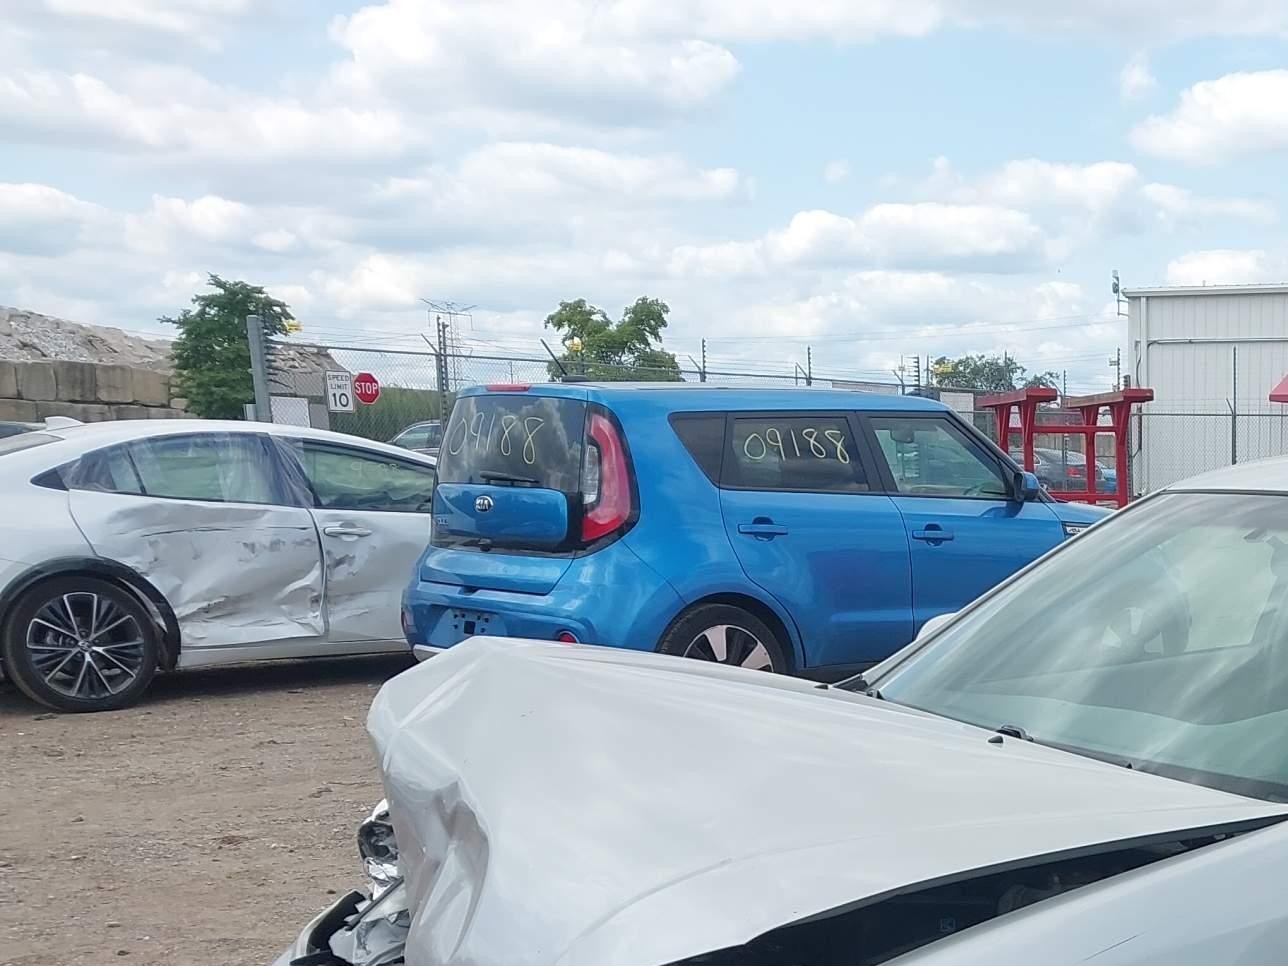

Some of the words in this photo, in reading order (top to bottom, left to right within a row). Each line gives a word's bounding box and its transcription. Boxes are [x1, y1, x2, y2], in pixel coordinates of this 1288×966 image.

[354, 382, 378, 394] STOP
[332, 392, 349, 407] 10
[449, 412, 545, 464] 09188
[743, 427, 850, 464] 09188
[475, 499, 489, 510] KIA
